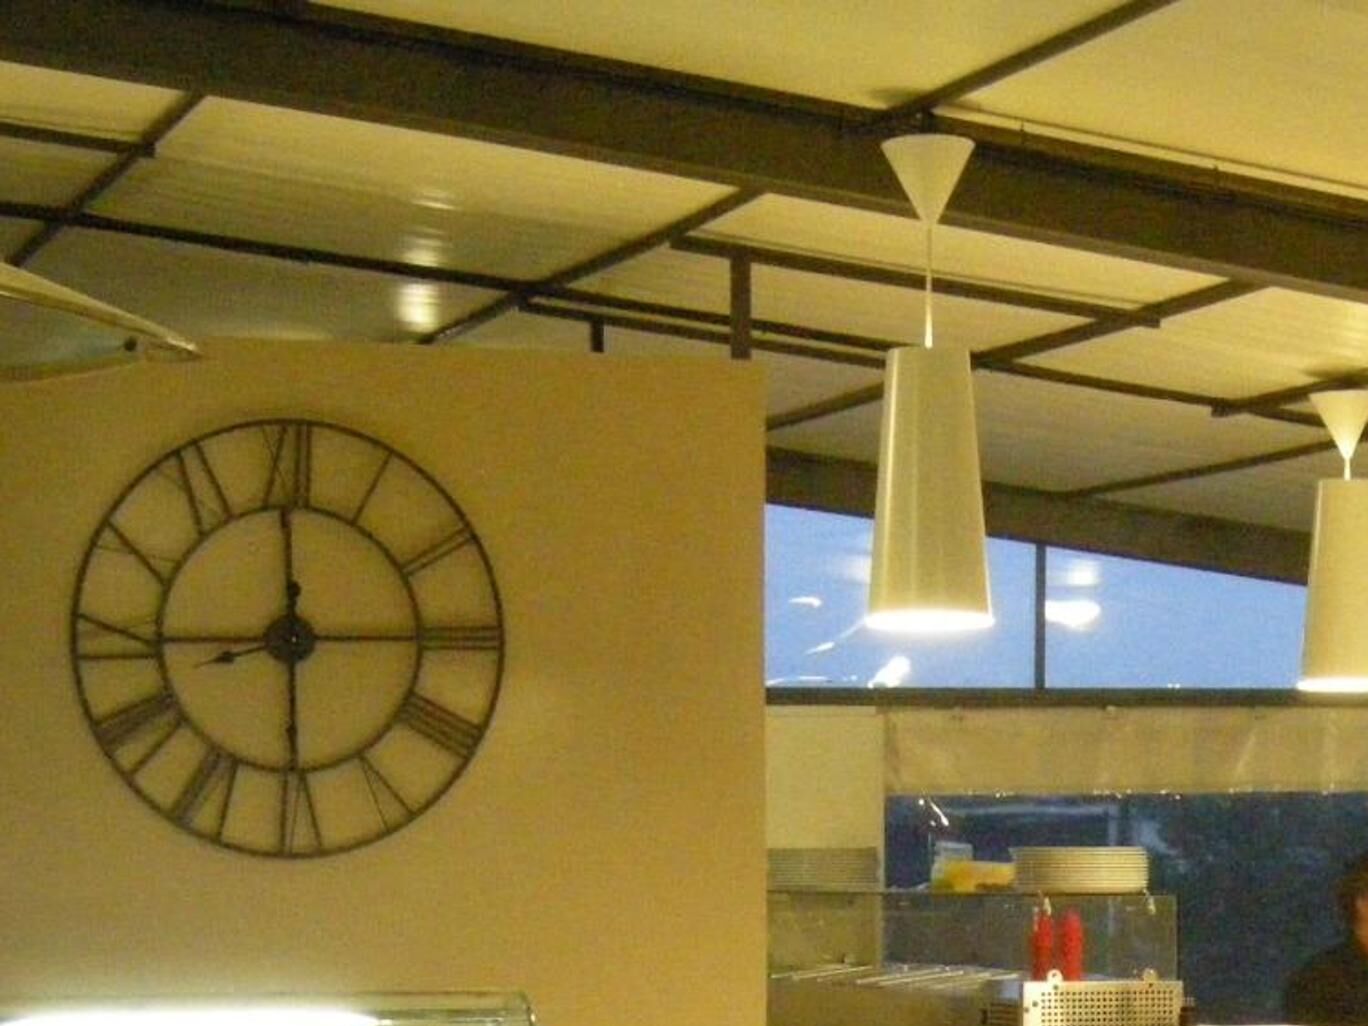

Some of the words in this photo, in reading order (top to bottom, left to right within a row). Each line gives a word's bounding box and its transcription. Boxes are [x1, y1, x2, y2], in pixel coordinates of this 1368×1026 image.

[262, 423, 312, 507] XII
[352, 451, 394, 526] I
[95, 523, 179, 586] X
[402, 527, 473, 577] II
[76, 613, 159, 659] IX
[420, 626, 501, 650] III
[280, 772, 322, 855] VI
[360, 755, 414, 834] V
